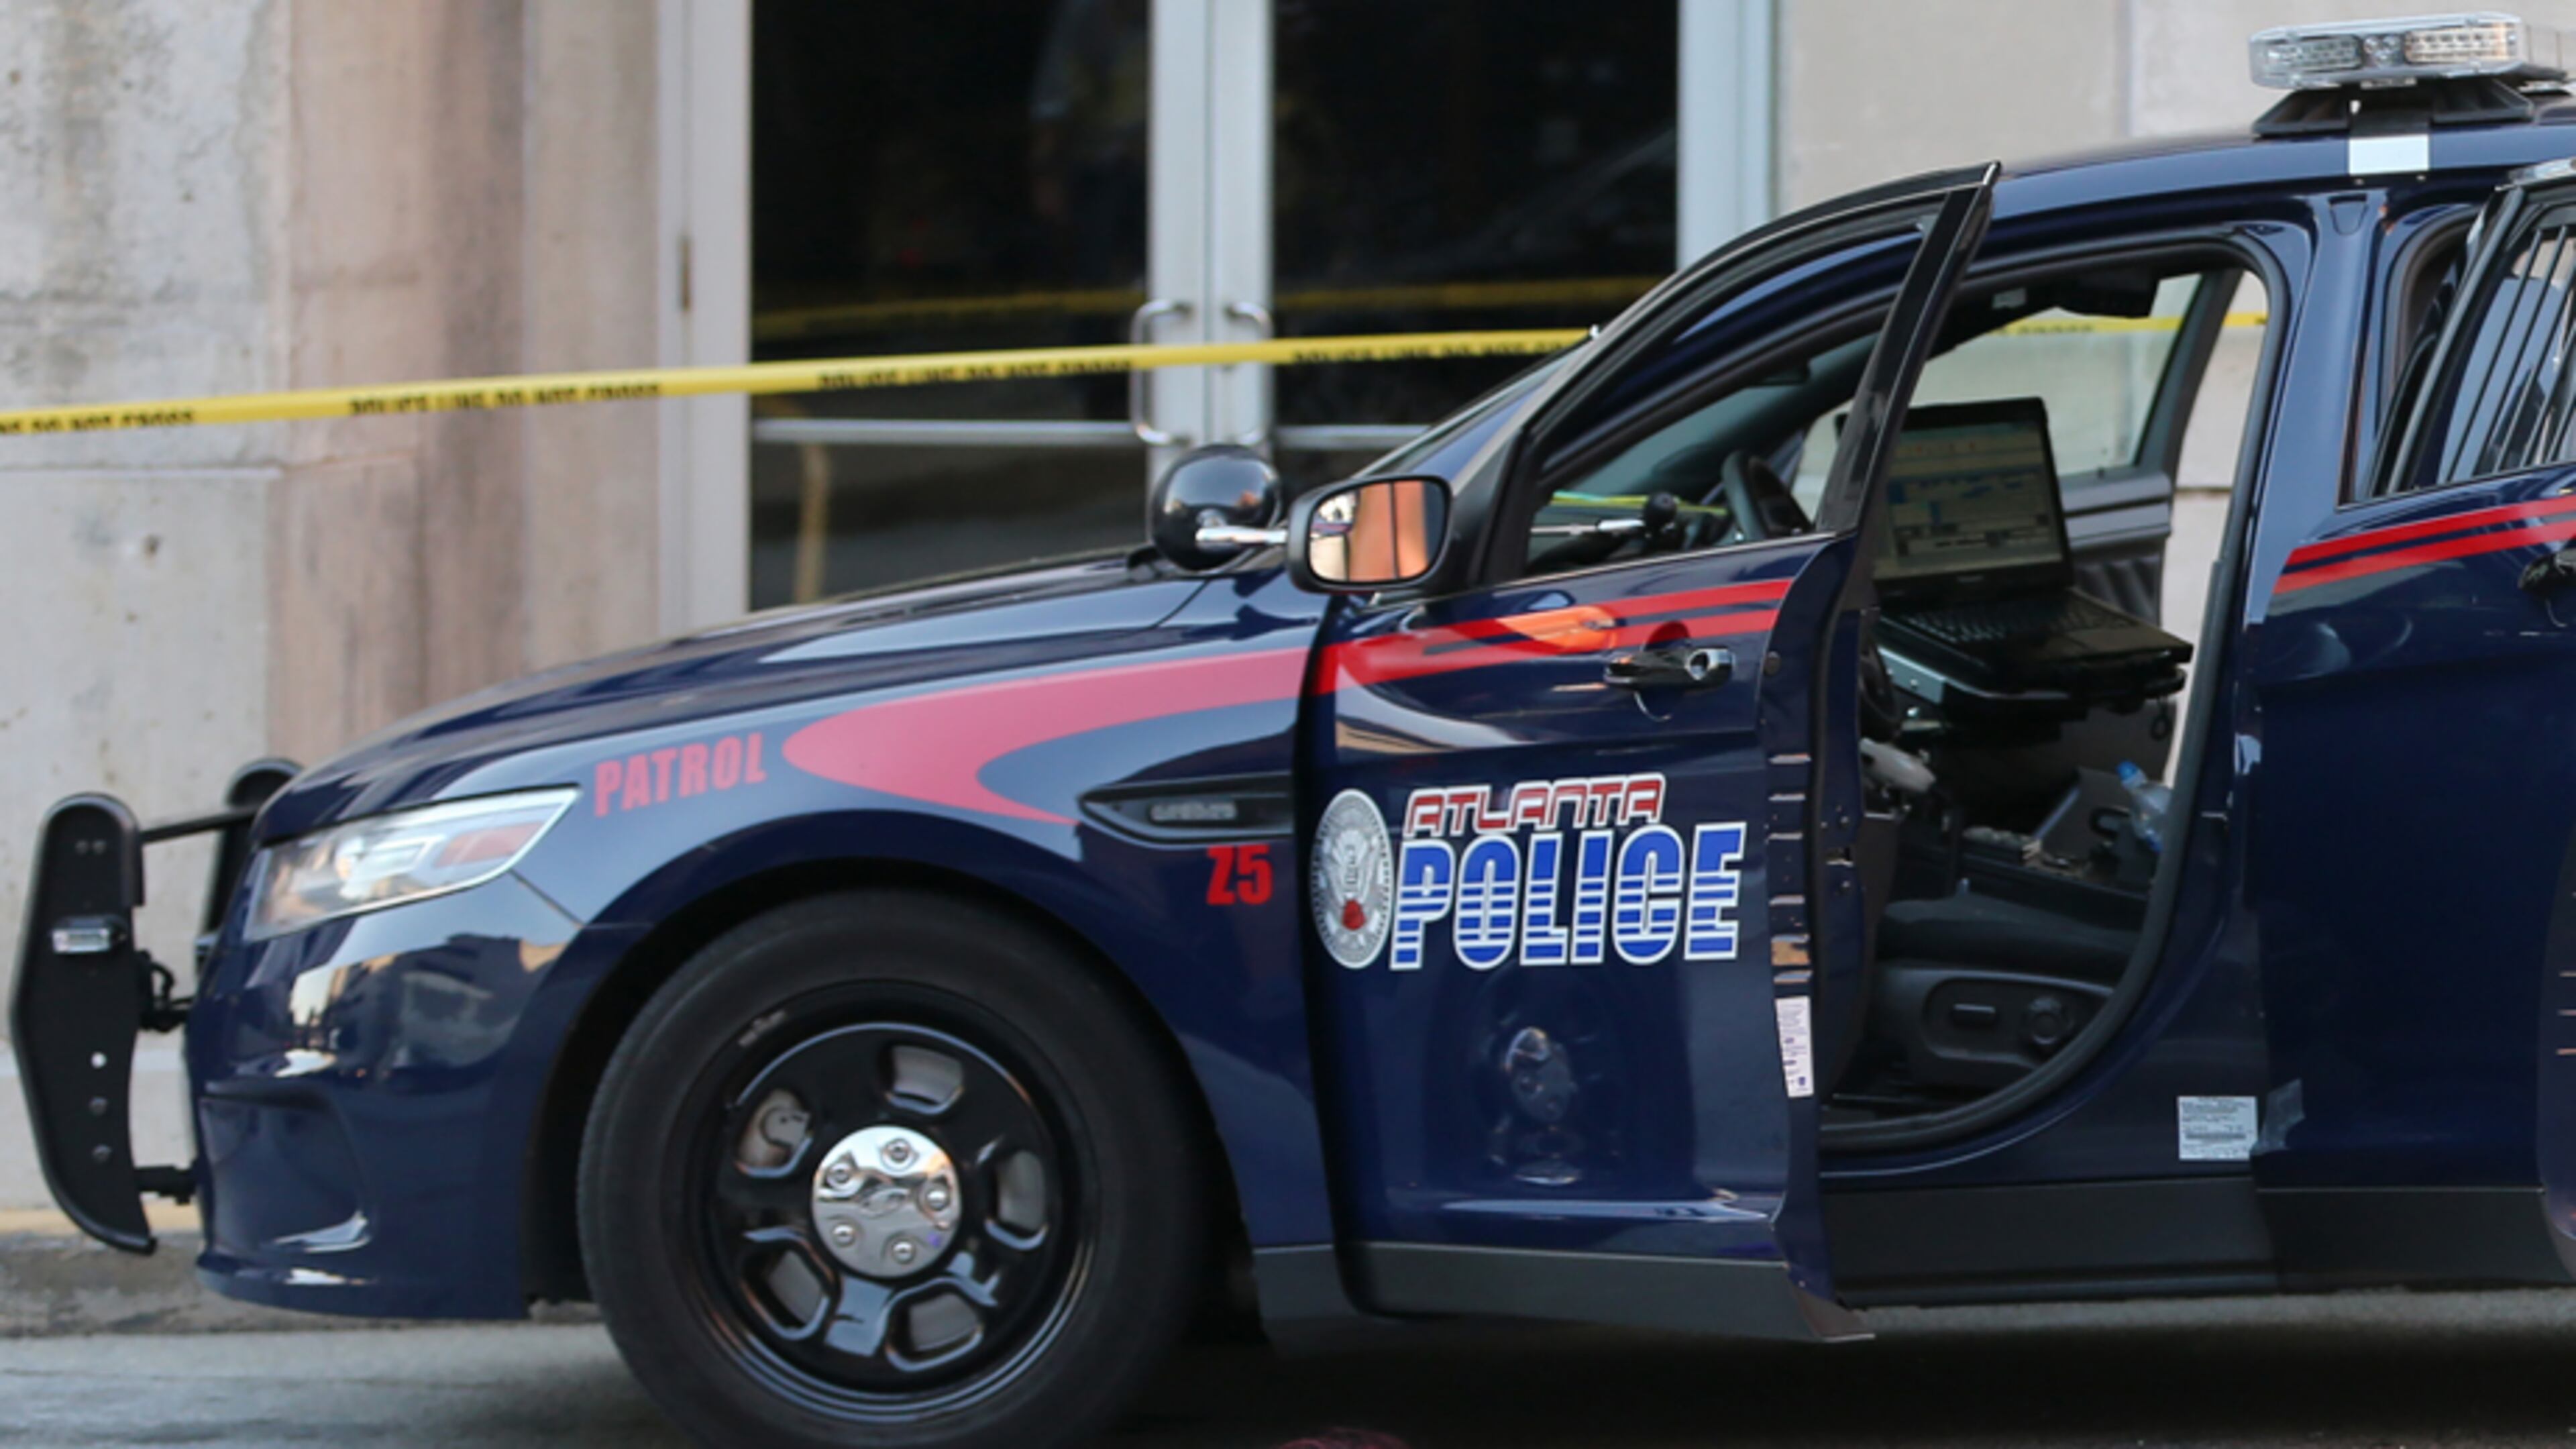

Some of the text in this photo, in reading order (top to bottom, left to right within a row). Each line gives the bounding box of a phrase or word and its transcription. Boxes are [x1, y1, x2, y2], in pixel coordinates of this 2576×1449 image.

[594, 732, 767, 818] PATROL
[1403, 773, 1666, 838] ATLANTA
[1206, 843, 1272, 905] Z5
[1389, 822, 1747, 970] POLICE
